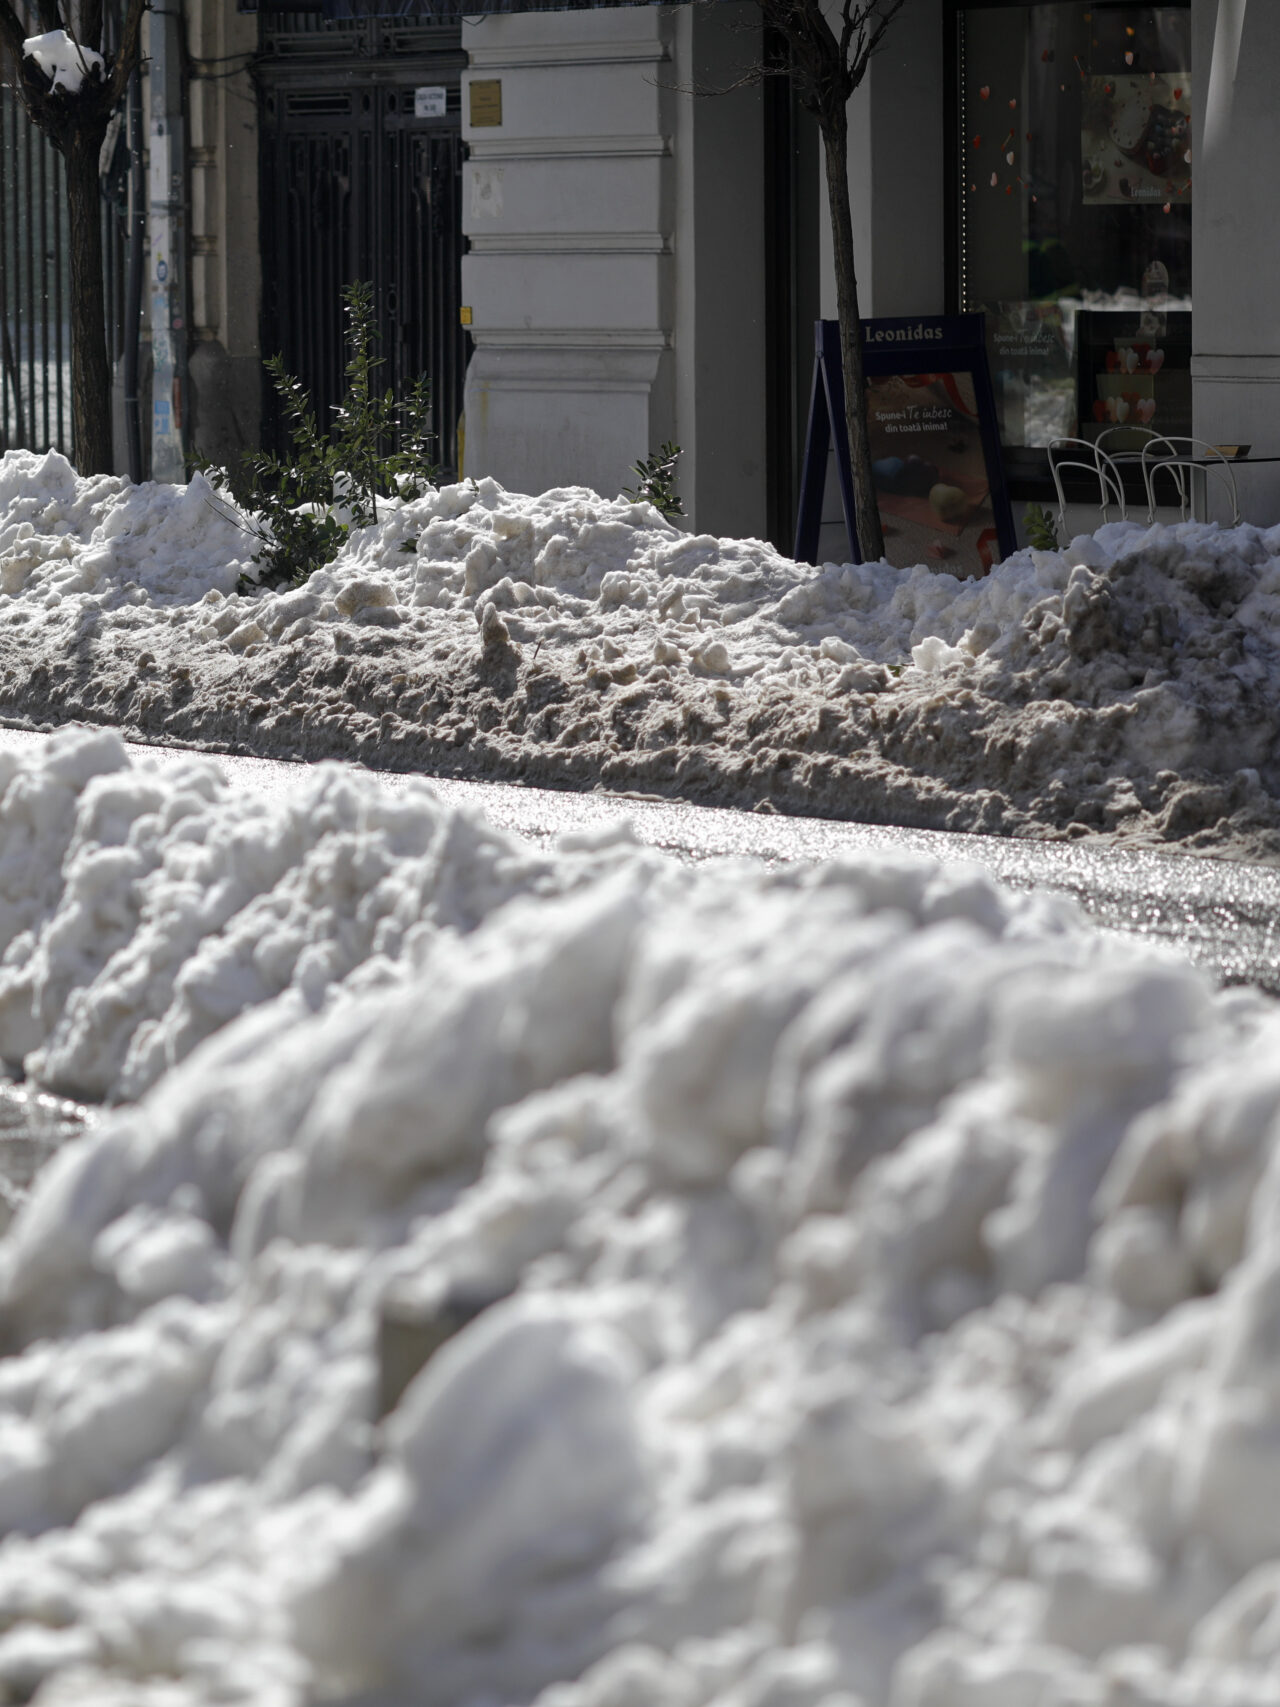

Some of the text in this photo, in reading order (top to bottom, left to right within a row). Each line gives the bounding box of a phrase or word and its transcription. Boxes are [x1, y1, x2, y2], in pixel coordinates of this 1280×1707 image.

[865, 323, 943, 342] Leonidas
[875, 404, 952, 422] Spune-i Te iubesc
[884, 422, 948, 433] din toată inima!
